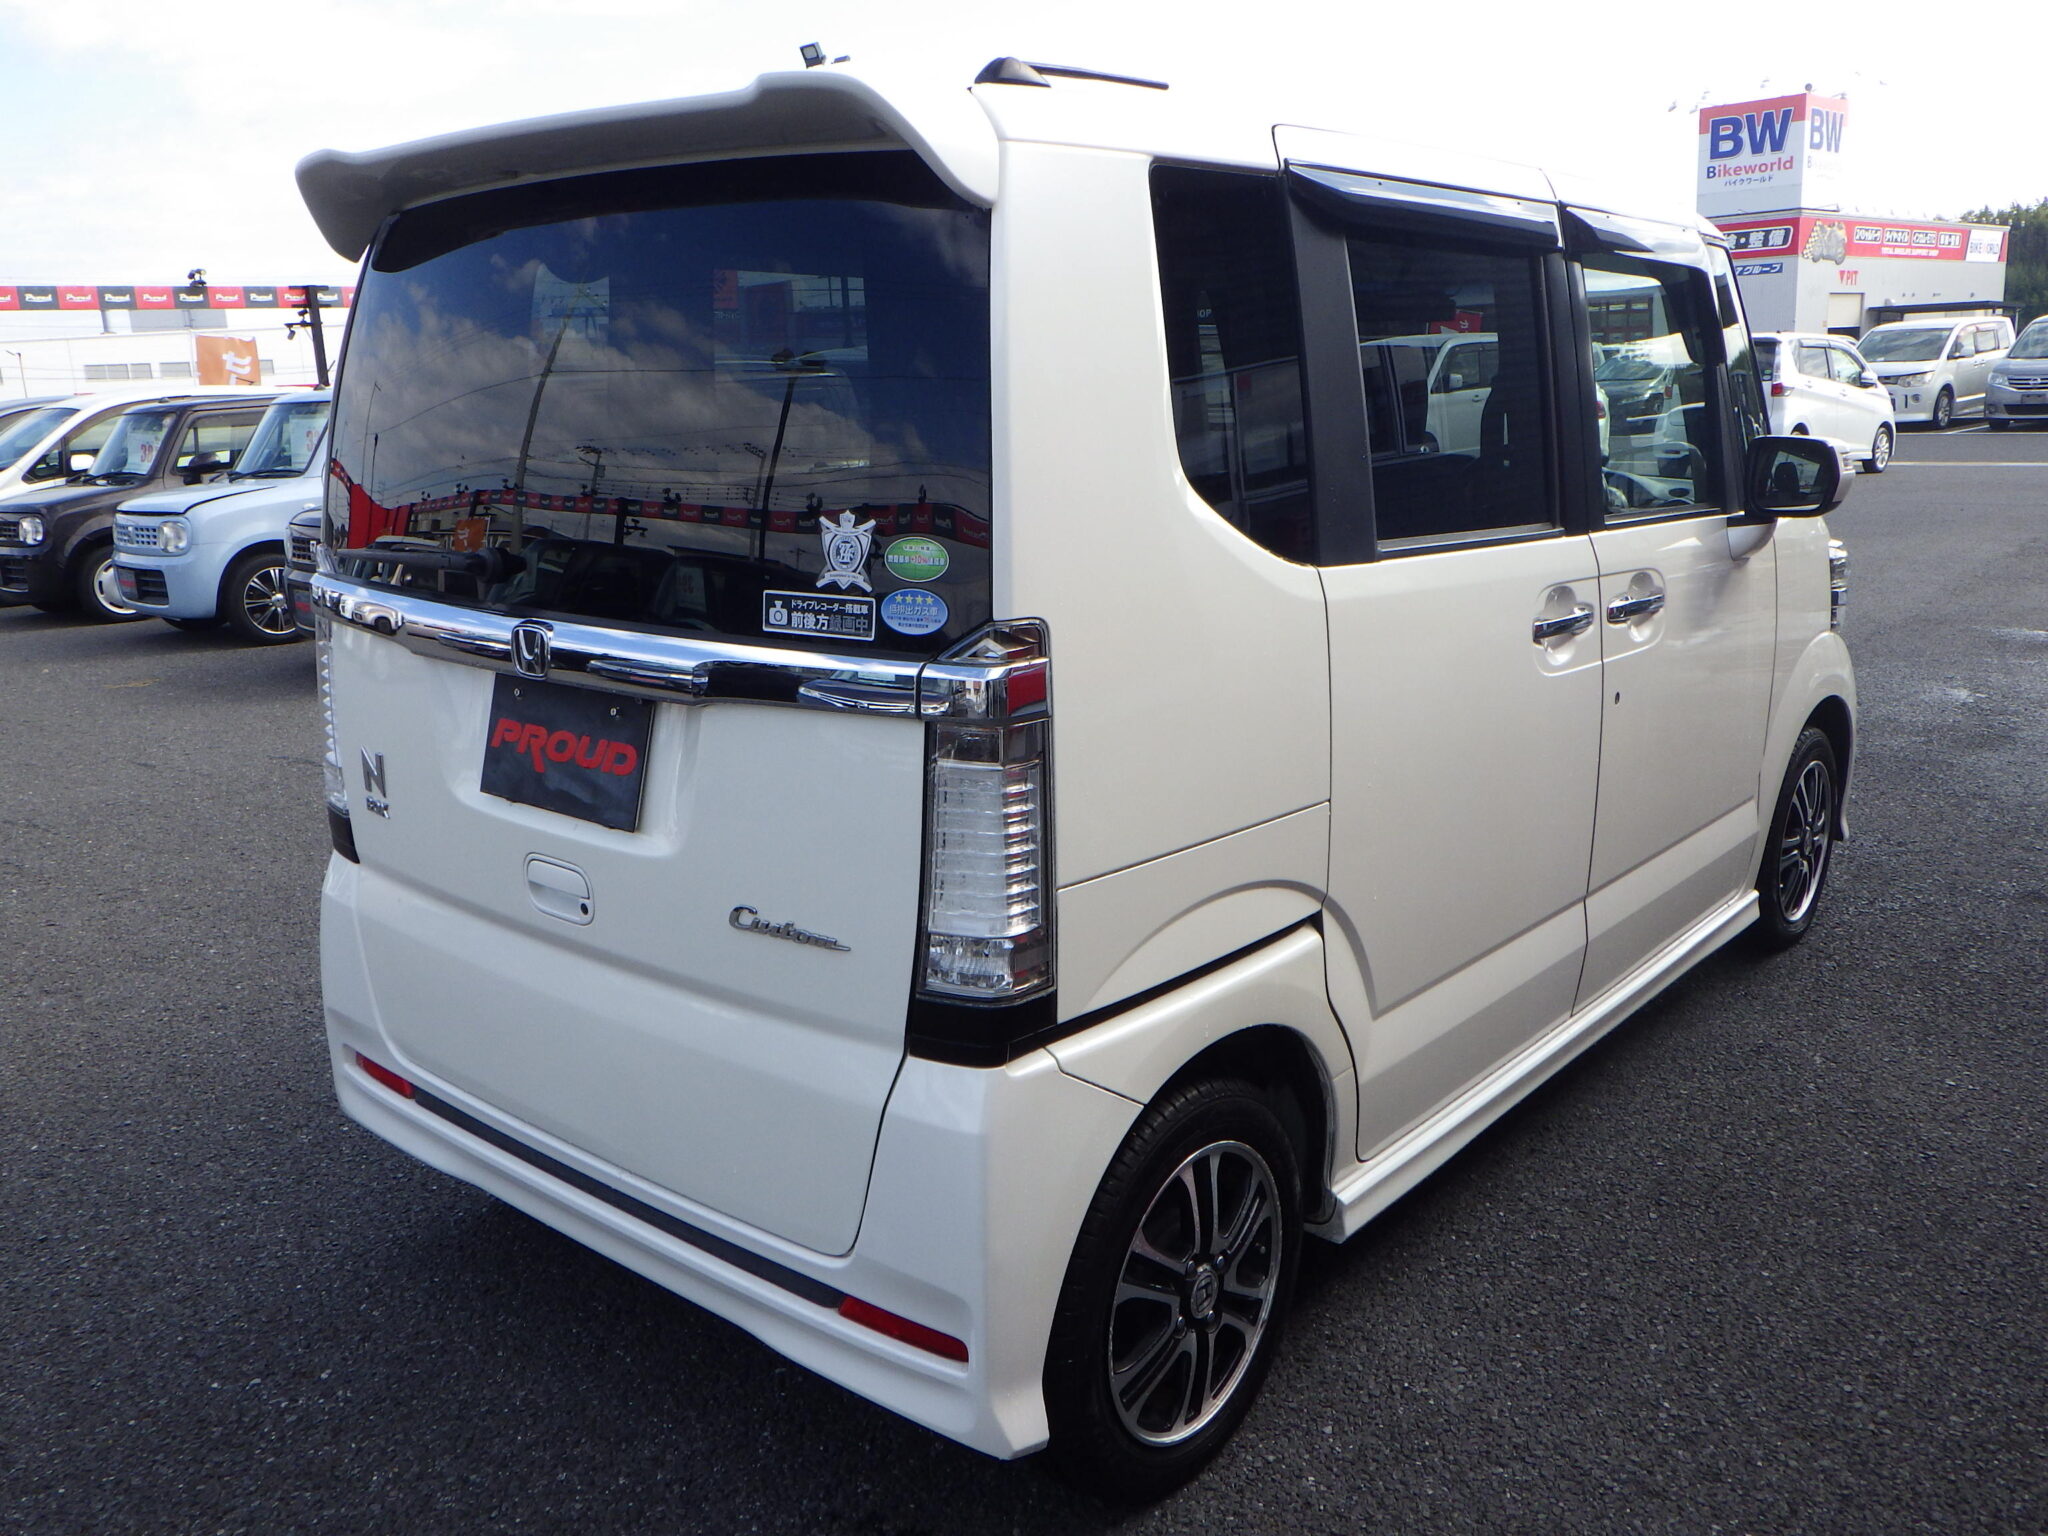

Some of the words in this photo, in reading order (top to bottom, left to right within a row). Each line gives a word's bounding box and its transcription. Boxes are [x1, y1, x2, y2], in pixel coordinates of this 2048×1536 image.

[1710, 107, 1794, 161] BW
[1809, 108, 1844, 153] BW
[1706, 156, 1794, 179] Bikeworld
[1724, 175, 1774, 187] バイクワールド
[1846, 270, 1859, 286] PIT
[791, 611, 869, 633] 前後方録画中
[491, 718, 638, 776] PROUD
[361, 745, 387, 799] N
[729, 905, 852, 952] Custom
